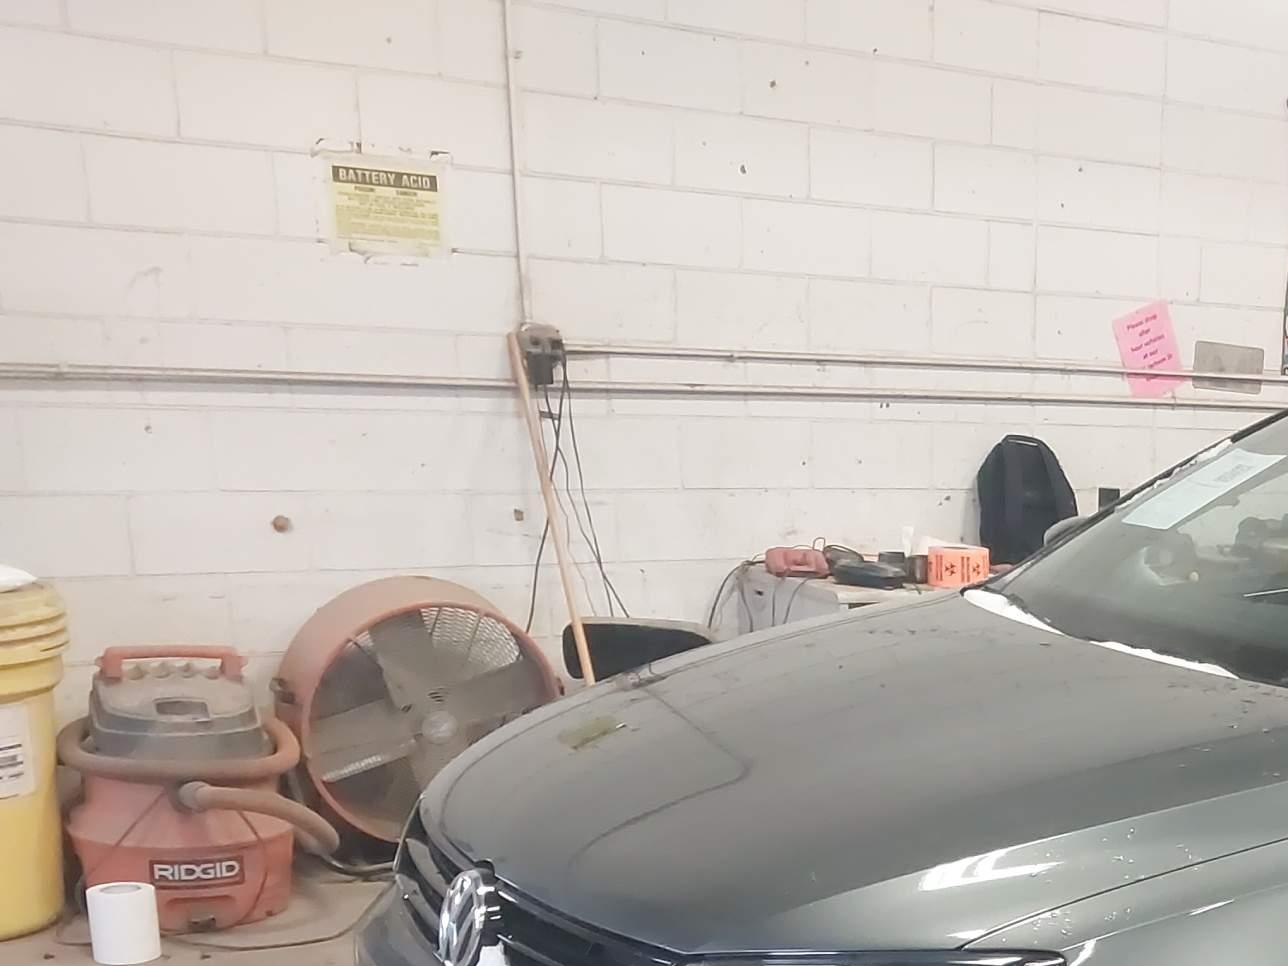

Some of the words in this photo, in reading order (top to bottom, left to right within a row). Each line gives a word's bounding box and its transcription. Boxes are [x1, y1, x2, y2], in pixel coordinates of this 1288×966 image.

[338, 168, 396, 185] BATTERY
[401, 175, 430, 189] ACID
[153, 861, 240, 880] RIDGID
